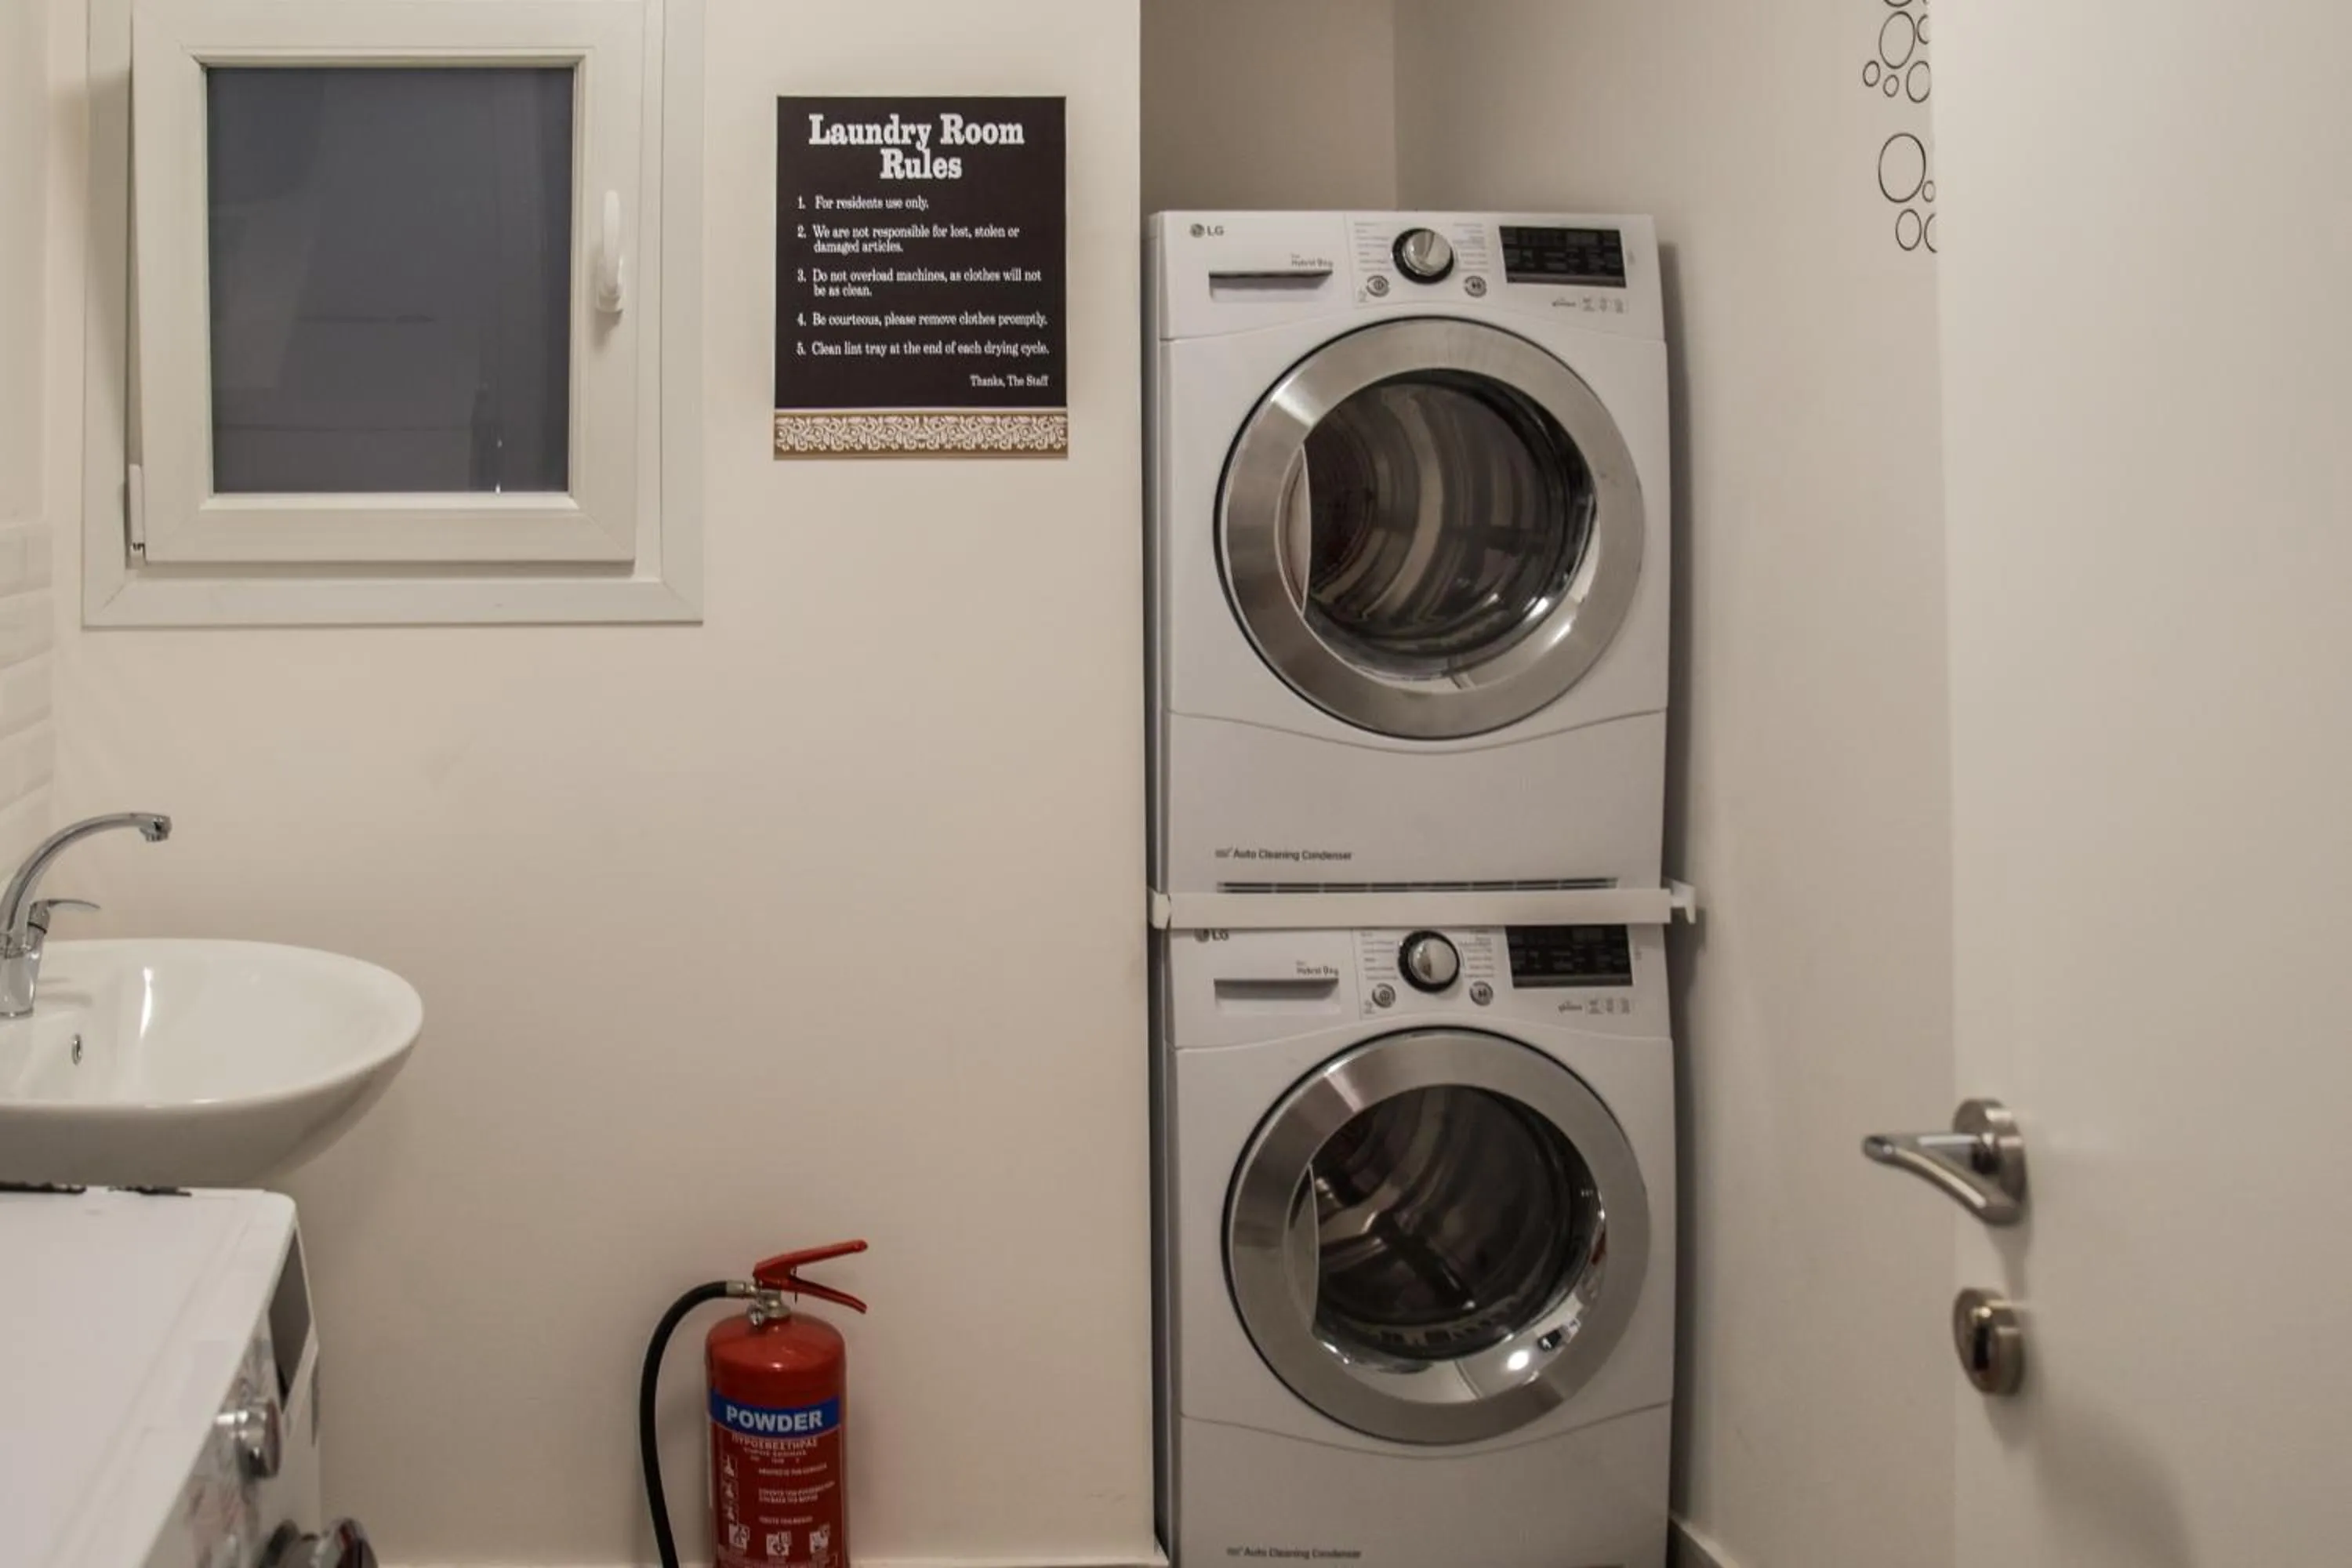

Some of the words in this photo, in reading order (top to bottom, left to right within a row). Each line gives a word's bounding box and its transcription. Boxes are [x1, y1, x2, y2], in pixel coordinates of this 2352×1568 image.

[808, 113, 932, 151] Laundry
[939, 113, 1025, 145] Room
[879, 147, 963, 180] Rules
[797, 196, 806, 210] 1.
[815, 195, 834, 210] For
[836, 195, 884, 210] residents
[885, 198, 903, 210] use
[906, 195, 929, 212] only.
[797, 225, 807, 239] 2.
[812, 224, 831, 238] We
[832, 227, 851, 238] are
[852, 226, 870, 238] not
[872, 224, 931, 241] responsible
[931, 224, 948, 238] for
[949, 224, 973, 239] lost,
[974, 224, 1006, 238] stolen
[1007, 227, 1020, 238] or
[1207, 225, 1225, 236] LG
[813, 240, 860, 256] damaged
[861, 239, 904, 253] articles.
[797, 268, 807, 282] 3.
[812, 268, 829, 282] Do
[830, 270, 848, 282] not
[849, 268, 895, 282] overload
[896, 268, 948, 283] machines,
[949, 270, 962, 281] as
[963, 267, 1001, 281] clothes
[1002, 267, 1022, 281] will
[1024, 270, 1042, 281] not
[813, 283, 827, 297] be
[828, 286, 840, 297] as
[841, 283, 873, 297] clean.
[797, 312, 807, 326] 4.
[812, 312, 827, 326] Be
[828, 314, 883, 328] courteous,
[884, 311, 916, 328] please
[918, 314, 957, 325] remove
[958, 311, 996, 325] clothes
[998, 311, 1048, 328] promptly.
[797, 342, 807, 356] 5.
[811, 340, 842, 356] Clean
[844, 340, 863, 355] lint
[865, 343, 887, 358] tray
[889, 343, 901, 355] at
[902, 340, 921, 355] the
[923, 340, 943, 355] end
[945, 340, 956, 354] of
[957, 340, 982, 354] each
[983, 340, 1019, 358] drying
[1020, 340, 1050, 358] cycle.
[970, 374, 1005, 388] Thanks,
[1006, 374, 1025, 387] The
[1025, 374, 1049, 387] Staff
[1233, 849, 1256, 860] Auto
[1258, 849, 1300, 861] Cleaning
[1301, 850, 1352, 861] Condenser
[725, 1404, 823, 1433] POWDER
[1243, 1547, 1267, 1557] Auto
[1269, 1548, 1310, 1559] Cleaning
[1312, 1548, 1361, 1559] Condenser
